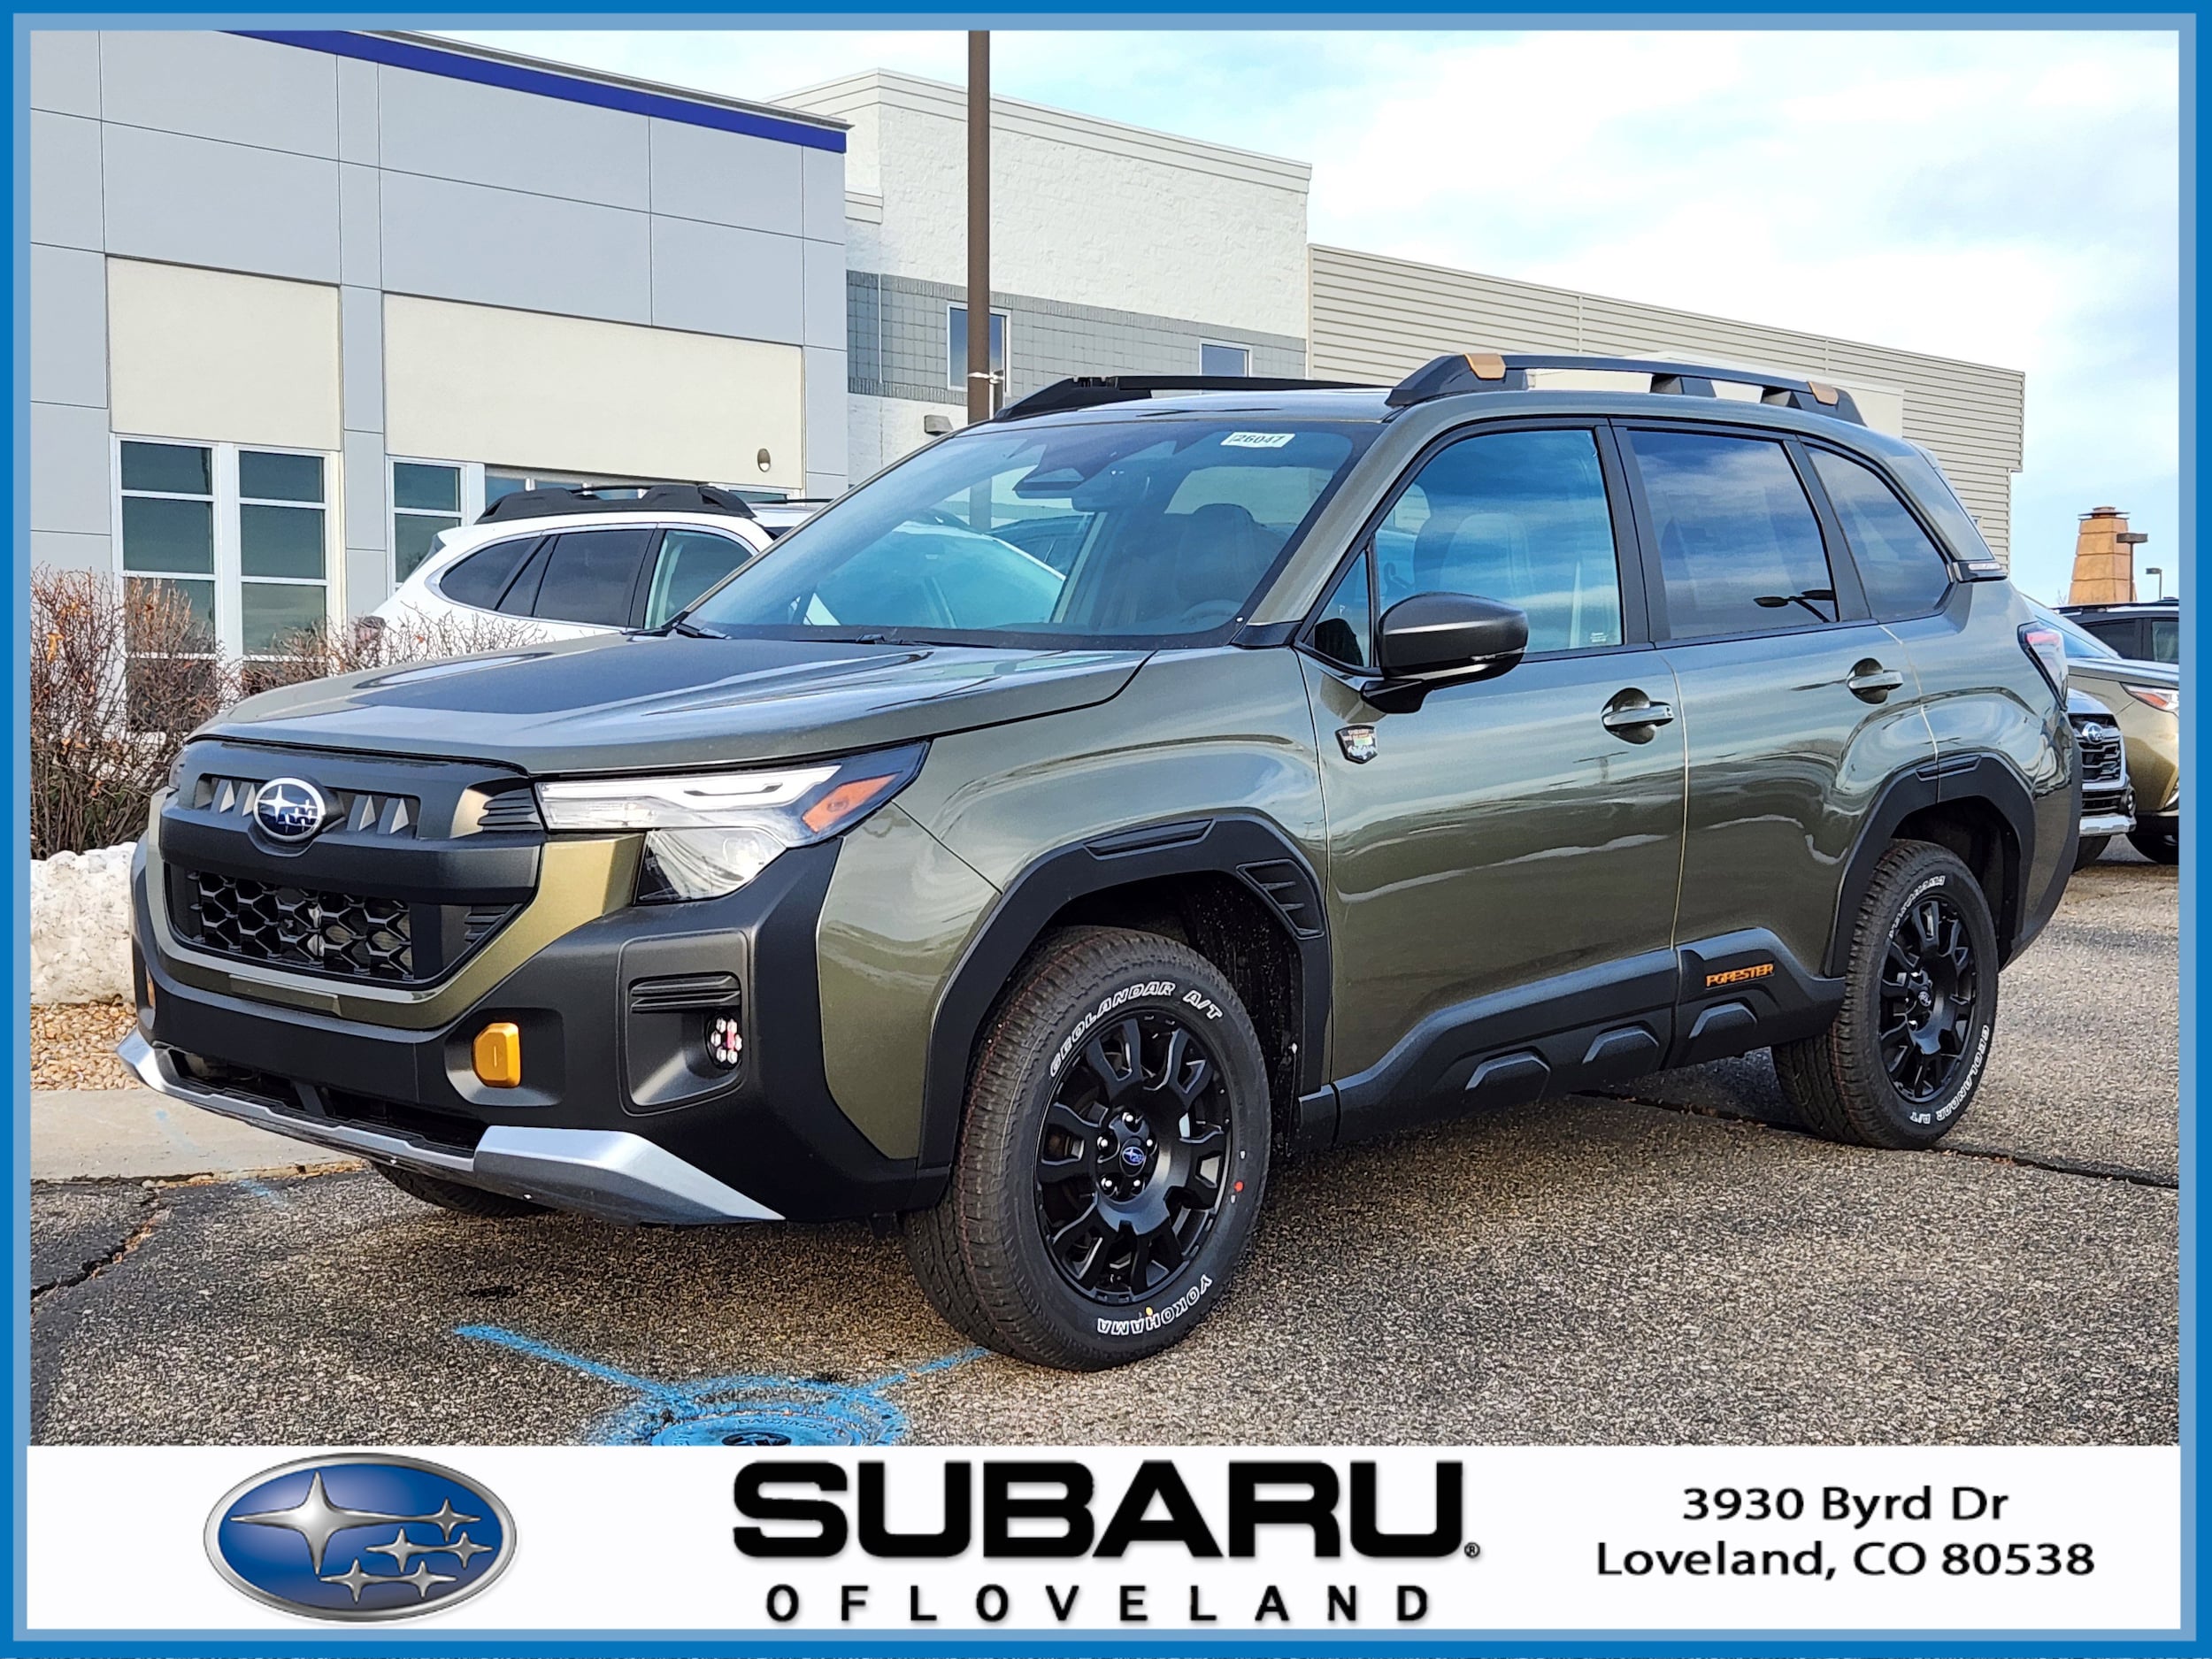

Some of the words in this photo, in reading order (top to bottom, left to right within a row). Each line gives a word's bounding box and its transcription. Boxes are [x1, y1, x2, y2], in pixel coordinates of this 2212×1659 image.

[1232, 434, 1286, 444] 26047
[1706, 964, 1774, 987] FORESTER
[1049, 981, 1176, 1078] GEOLANDAR
[1182, 990, 1224, 1020] A/T
[1936, 1025, 1991, 1122] GEOLANDAR
[1097, 1274, 1213, 1336] YOKOHAMA
